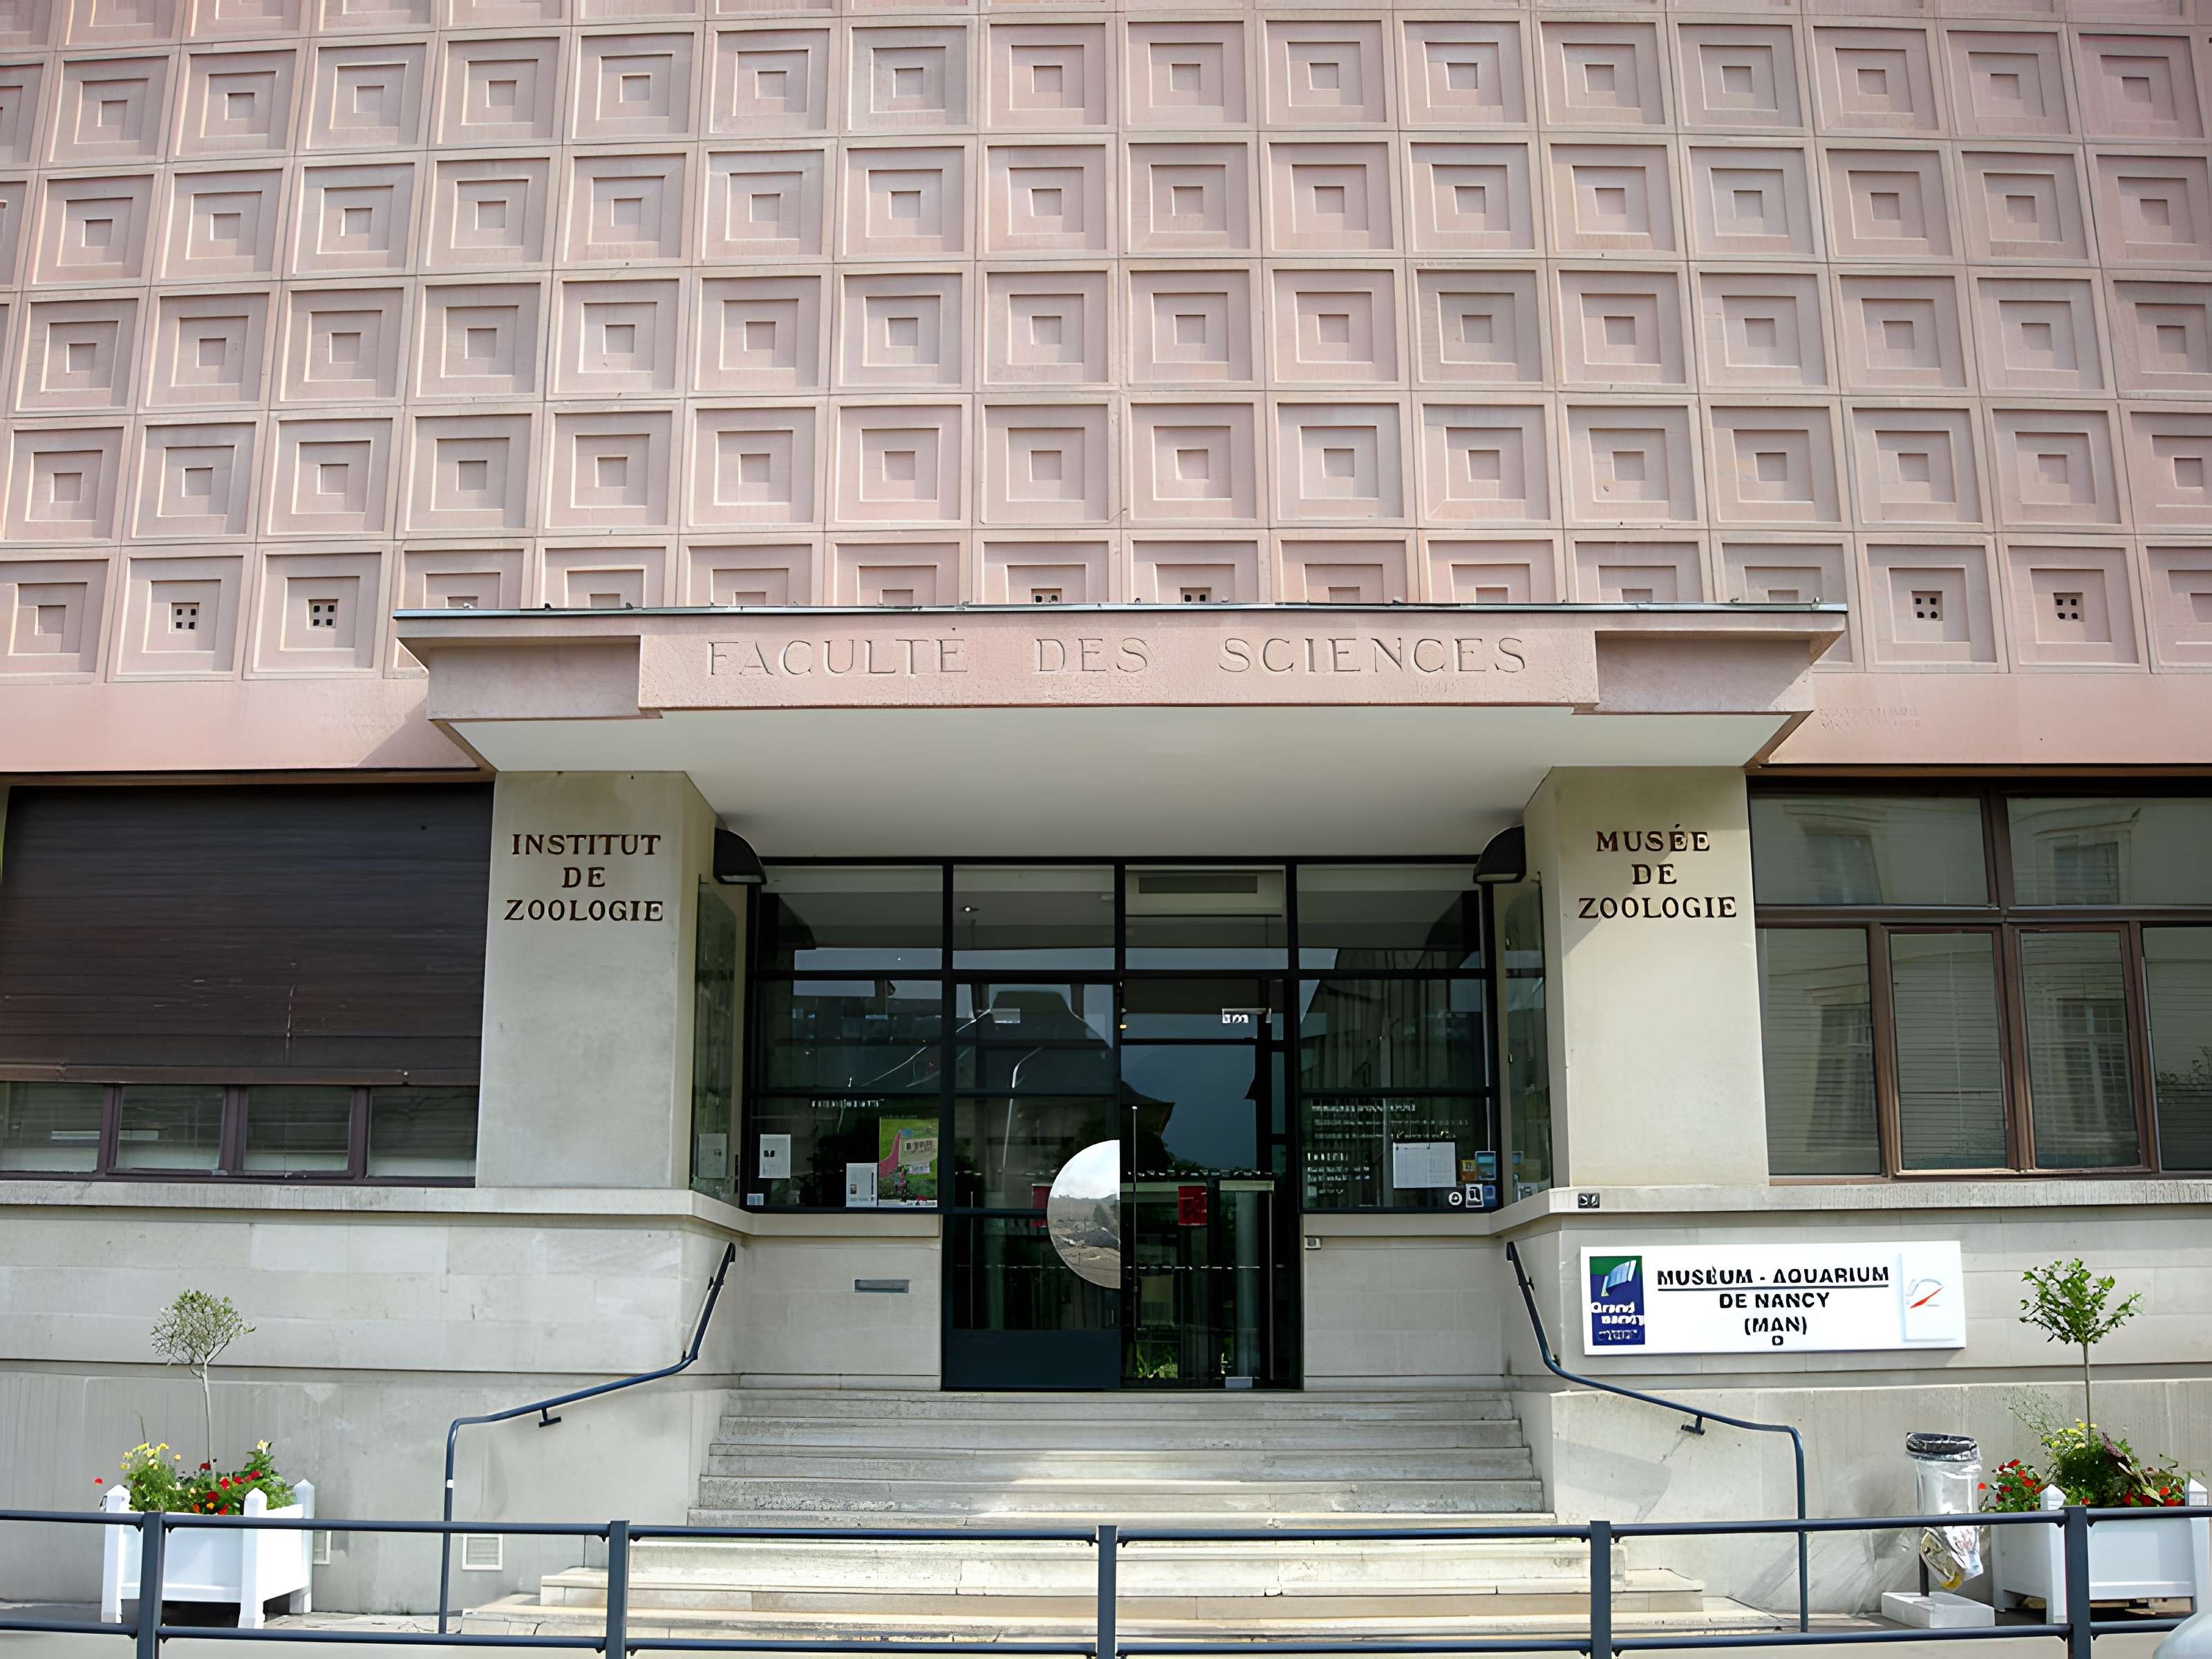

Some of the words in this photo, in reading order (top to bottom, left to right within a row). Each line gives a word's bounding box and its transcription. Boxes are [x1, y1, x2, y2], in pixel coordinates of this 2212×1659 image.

[707, 639, 968, 676] FACULTE
[1033, 637, 1148, 674] DES
[1217, 637, 1526, 675] SCIENCES
[512, 834, 662, 856] INSTITUT
[1595, 823, 1711, 852] MUSÉE
[561, 867, 606, 888] DE
[1631, 863, 1678, 885] DE
[503, 899, 664, 921] ZOOLOGIE
[1577, 896, 1737, 919] ZOOLOGIE
[1718, 1293, 1747, 1309] DE
[1754, 1292, 1830, 1309] NANCY
[1743, 1316, 1808, 1335] (MAN)
